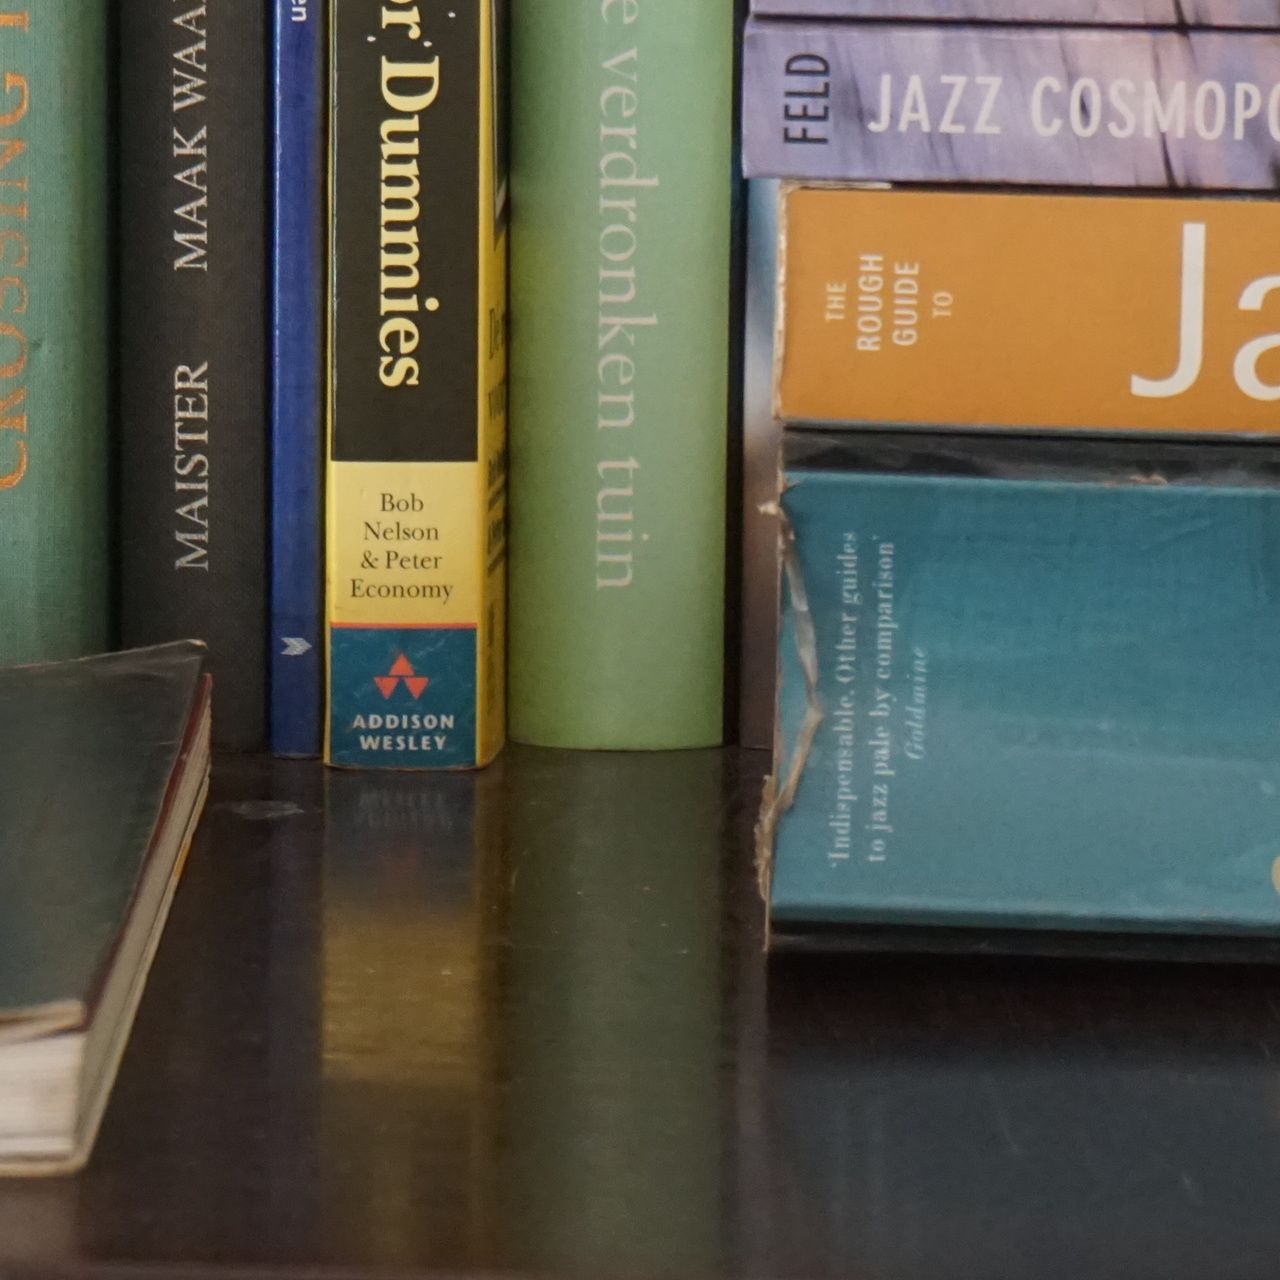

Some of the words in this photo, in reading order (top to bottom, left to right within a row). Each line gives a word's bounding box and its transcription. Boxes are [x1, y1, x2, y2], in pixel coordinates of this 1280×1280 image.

[783, 52, 831, 146] FELD
[867, 74, 1002, 136] JAZZ
[173, 125, 208, 272] MAAK
[379, 56, 440, 387] Dummies
[596, 47, 659, 429] verdronken
[825, 281, 846, 323] THE
[856, 254, 884, 352] ROUGH
[892, 260, 920, 347] GUIDE
[932, 291, 953, 319] TO
[174, 361, 208, 571] MAISTER
[380, 492, 424, 514] Bob
[595, 457, 651, 590] tuin
[363, 521, 439, 543] Nelson
[361, 551, 379, 571] &
[385, 550, 442, 571] Peter
[836, 532, 863, 605] guides
[349, 579, 454, 605] Economy
[835, 612, 857, 683] Other
[353, 714, 455, 729] ADDISON
[868, 688, 897, 716] by
[904, 647, 928, 760] Goldmine
[360, 735, 446, 751] WESLEY
[869, 728, 895, 776] pale
[866, 784, 893, 833] jazz
[866, 839, 887, 862] to
